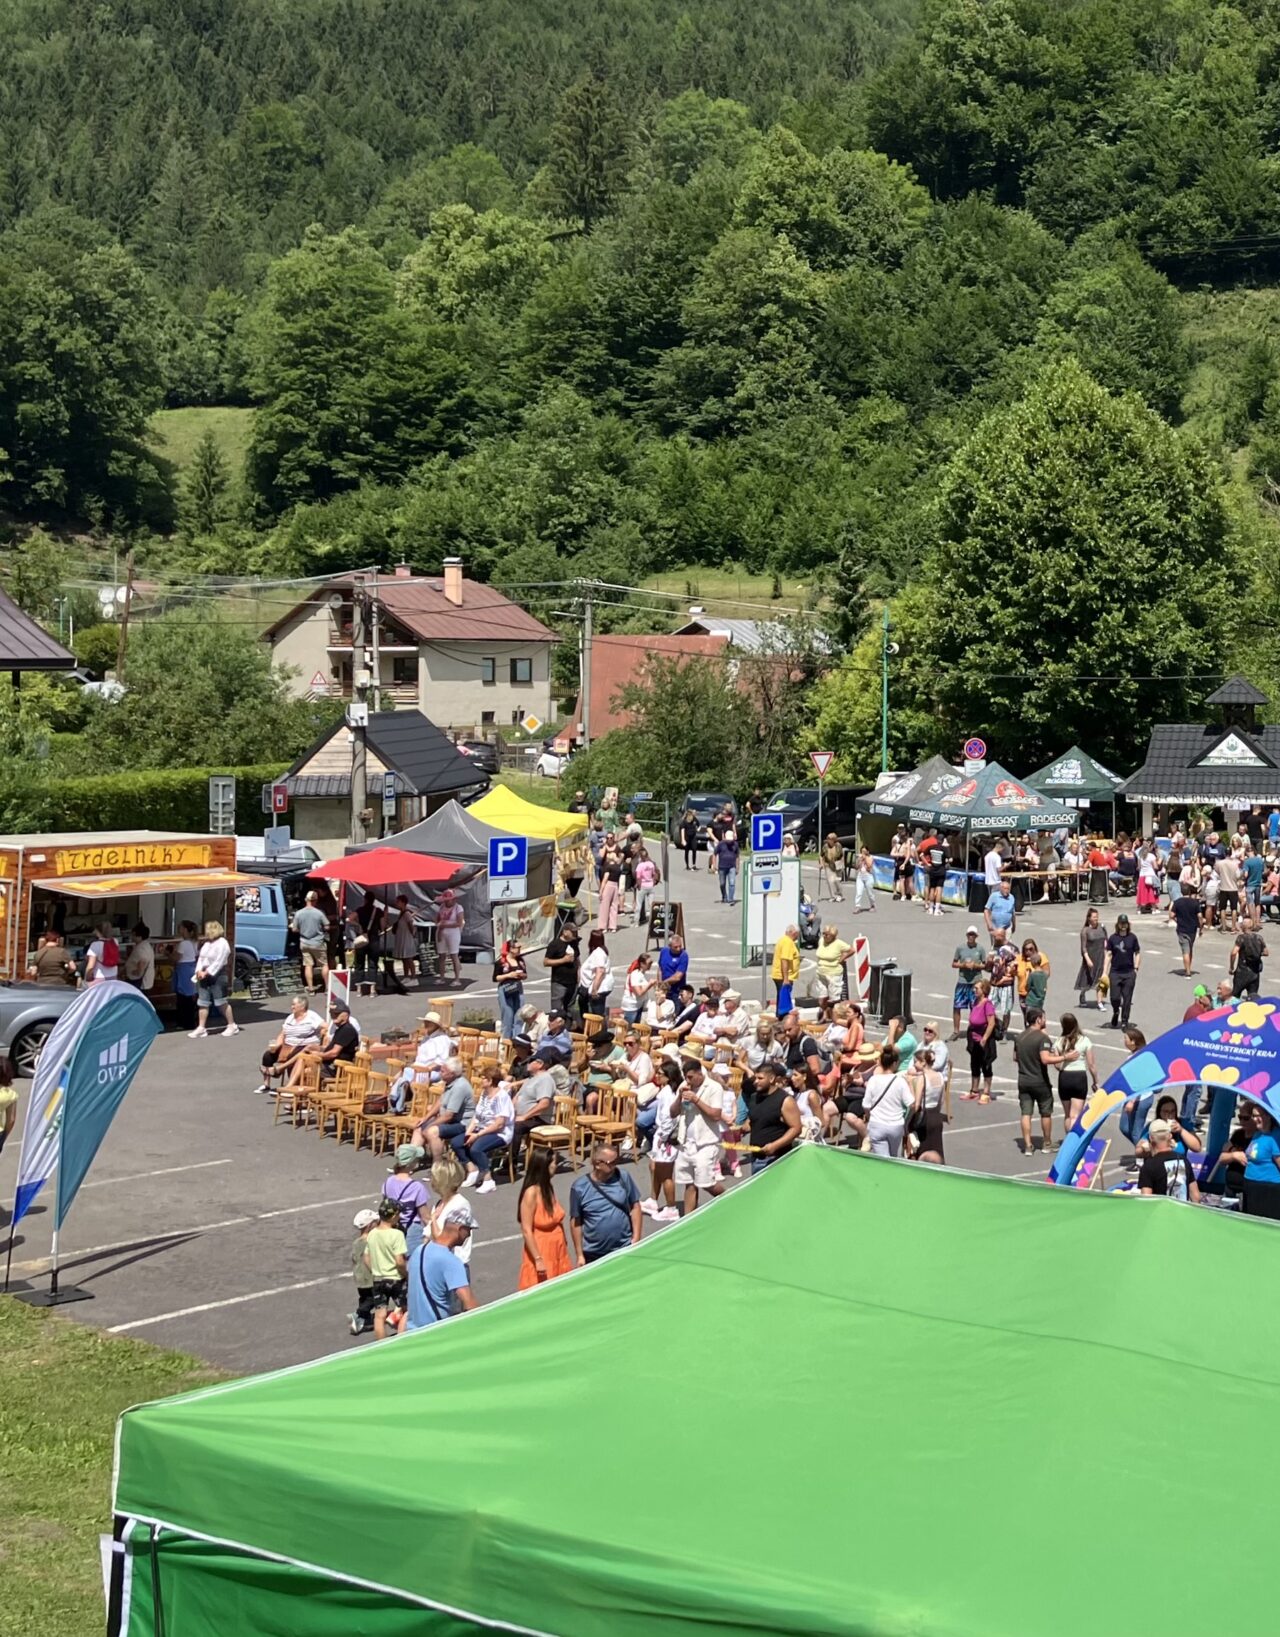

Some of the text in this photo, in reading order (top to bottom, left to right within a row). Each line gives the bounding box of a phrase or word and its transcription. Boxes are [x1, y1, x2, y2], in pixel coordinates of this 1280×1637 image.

[971, 815, 1020, 828] RADEGAST
[1030, 813, 1078, 826] RADEGAST
[759, 819, 776, 848] P
[497, 842, 518, 873] P
[1183, 1037, 1277, 1058] BANSKOBYSTRICKÝ KRAJ
